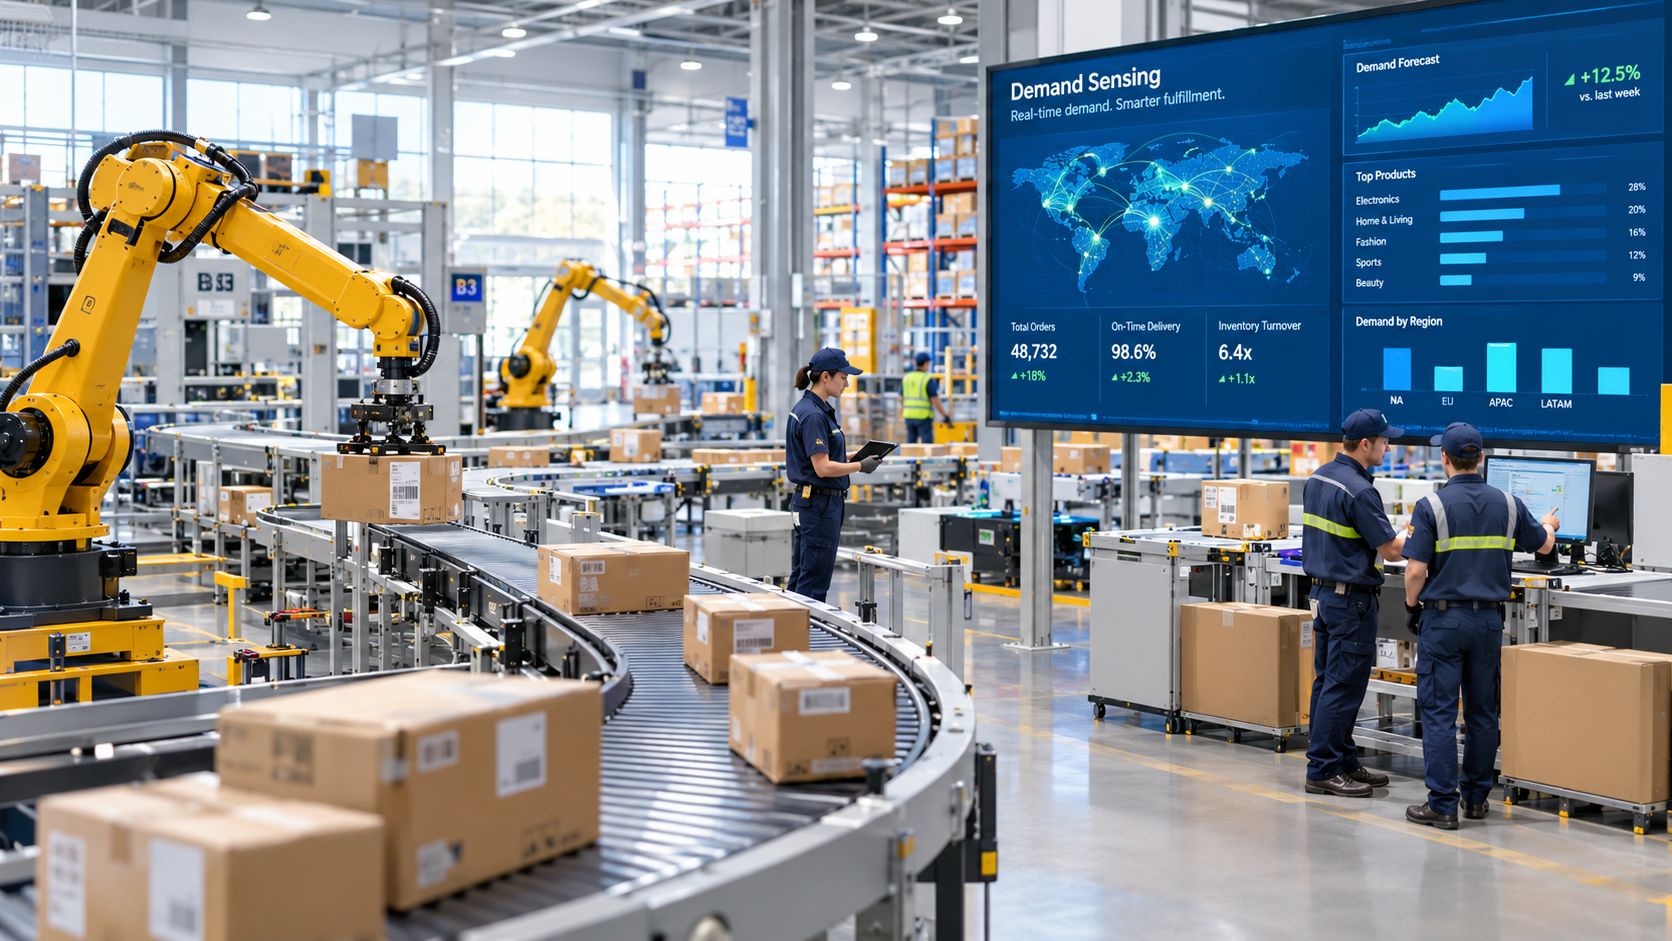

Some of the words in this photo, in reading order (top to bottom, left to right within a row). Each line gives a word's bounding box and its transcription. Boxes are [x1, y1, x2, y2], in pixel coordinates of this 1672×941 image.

[1356, 58, 1397, 73] Demand
[1398, 54, 1441, 69] Forecast
[1580, 63, 1641, 84] +12.5%
[1010, 73, 1084, 102] Demand
[1088, 66, 1161, 92] Sensing
[1579, 93, 1593, 102] vs.
[1594, 89, 1613, 101] last
[1614, 86, 1641, 98] week
[1011, 106, 1062, 122] Real-time
[1064, 98, 1113, 116] demand.
[1115, 95, 1161, 111] Smarter
[1163, 87, 1226, 106] fulfillment.
[1355, 171, 1374, 184] Top
[1375, 168, 1417, 181] Products
[1628, 182, 1647, 192] 28%
[1355, 194, 1400, 206] Electronics
[1628, 204, 1647, 215] 20%
[1355, 216, 1380, 226] Home
[1381, 215, 1388, 225] &
[1389, 214, 1413, 226] Living
[1628, 227, 1647, 237] 16%
[1355, 236, 1387, 247] Fashion
[1628, 250, 1647, 260] 12%
[1355, 257, 1382, 269] Sports
[1632, 272, 1646, 282] 9%
[456, 278, 477, 296] B3
[1355, 278, 1385, 289] Beauty
[1010, 321, 1030, 332] Total
[1030, 321, 1056, 332] Orders
[1111, 320, 1146, 332] On-Time
[1147, 321, 1181, 334] Delivery
[1218, 320, 1260, 333] Inventory
[1261, 320, 1302, 331] Turnover
[1355, 315, 1395, 327] Demand
[1396, 315, 1409, 329] by
[1409, 315, 1443, 329] Region
[1010, 343, 1058, 362] 48,732
[1111, 343, 1157, 360] 98.6%
[1218, 343, 1253, 361] 6.4x
[1019, 369, 1047, 382] +18%
[1120, 371, 1151, 383] +2.3%
[1228, 372, 1256, 384] +1.1x
[1390, 395, 1404, 405] NA
[1441, 396, 1454, 406] EU
[1488, 397, 1514, 408] APAC
[1540, 399, 1573, 409] LATAM
